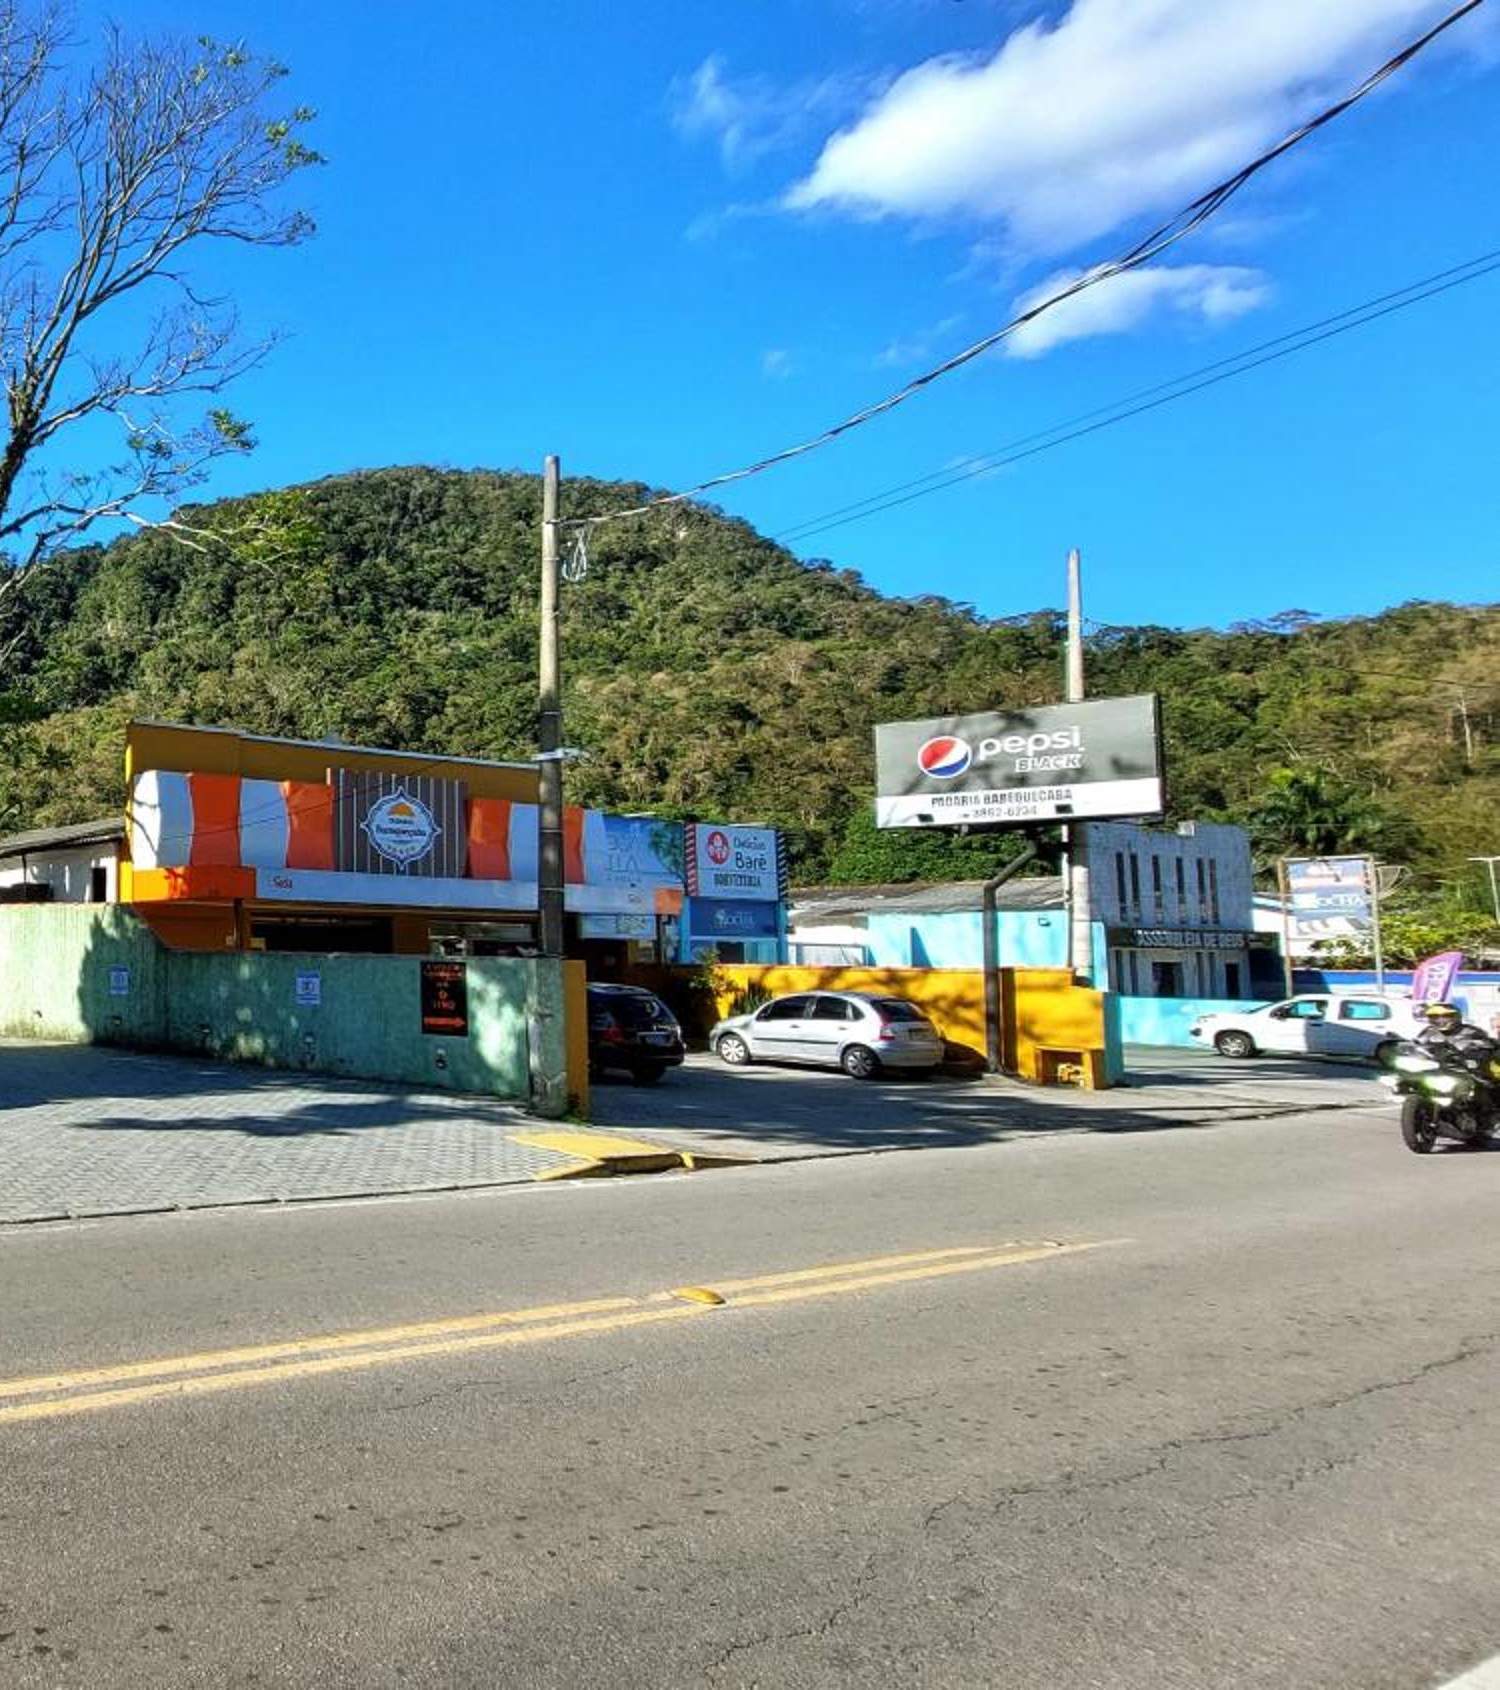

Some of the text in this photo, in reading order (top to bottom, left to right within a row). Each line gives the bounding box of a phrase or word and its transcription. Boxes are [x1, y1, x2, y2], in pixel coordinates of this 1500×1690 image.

[979, 725, 1081, 761] pepsi
[1015, 753, 1083, 773] BLACK
[931, 794, 981, 808] PADARIA
